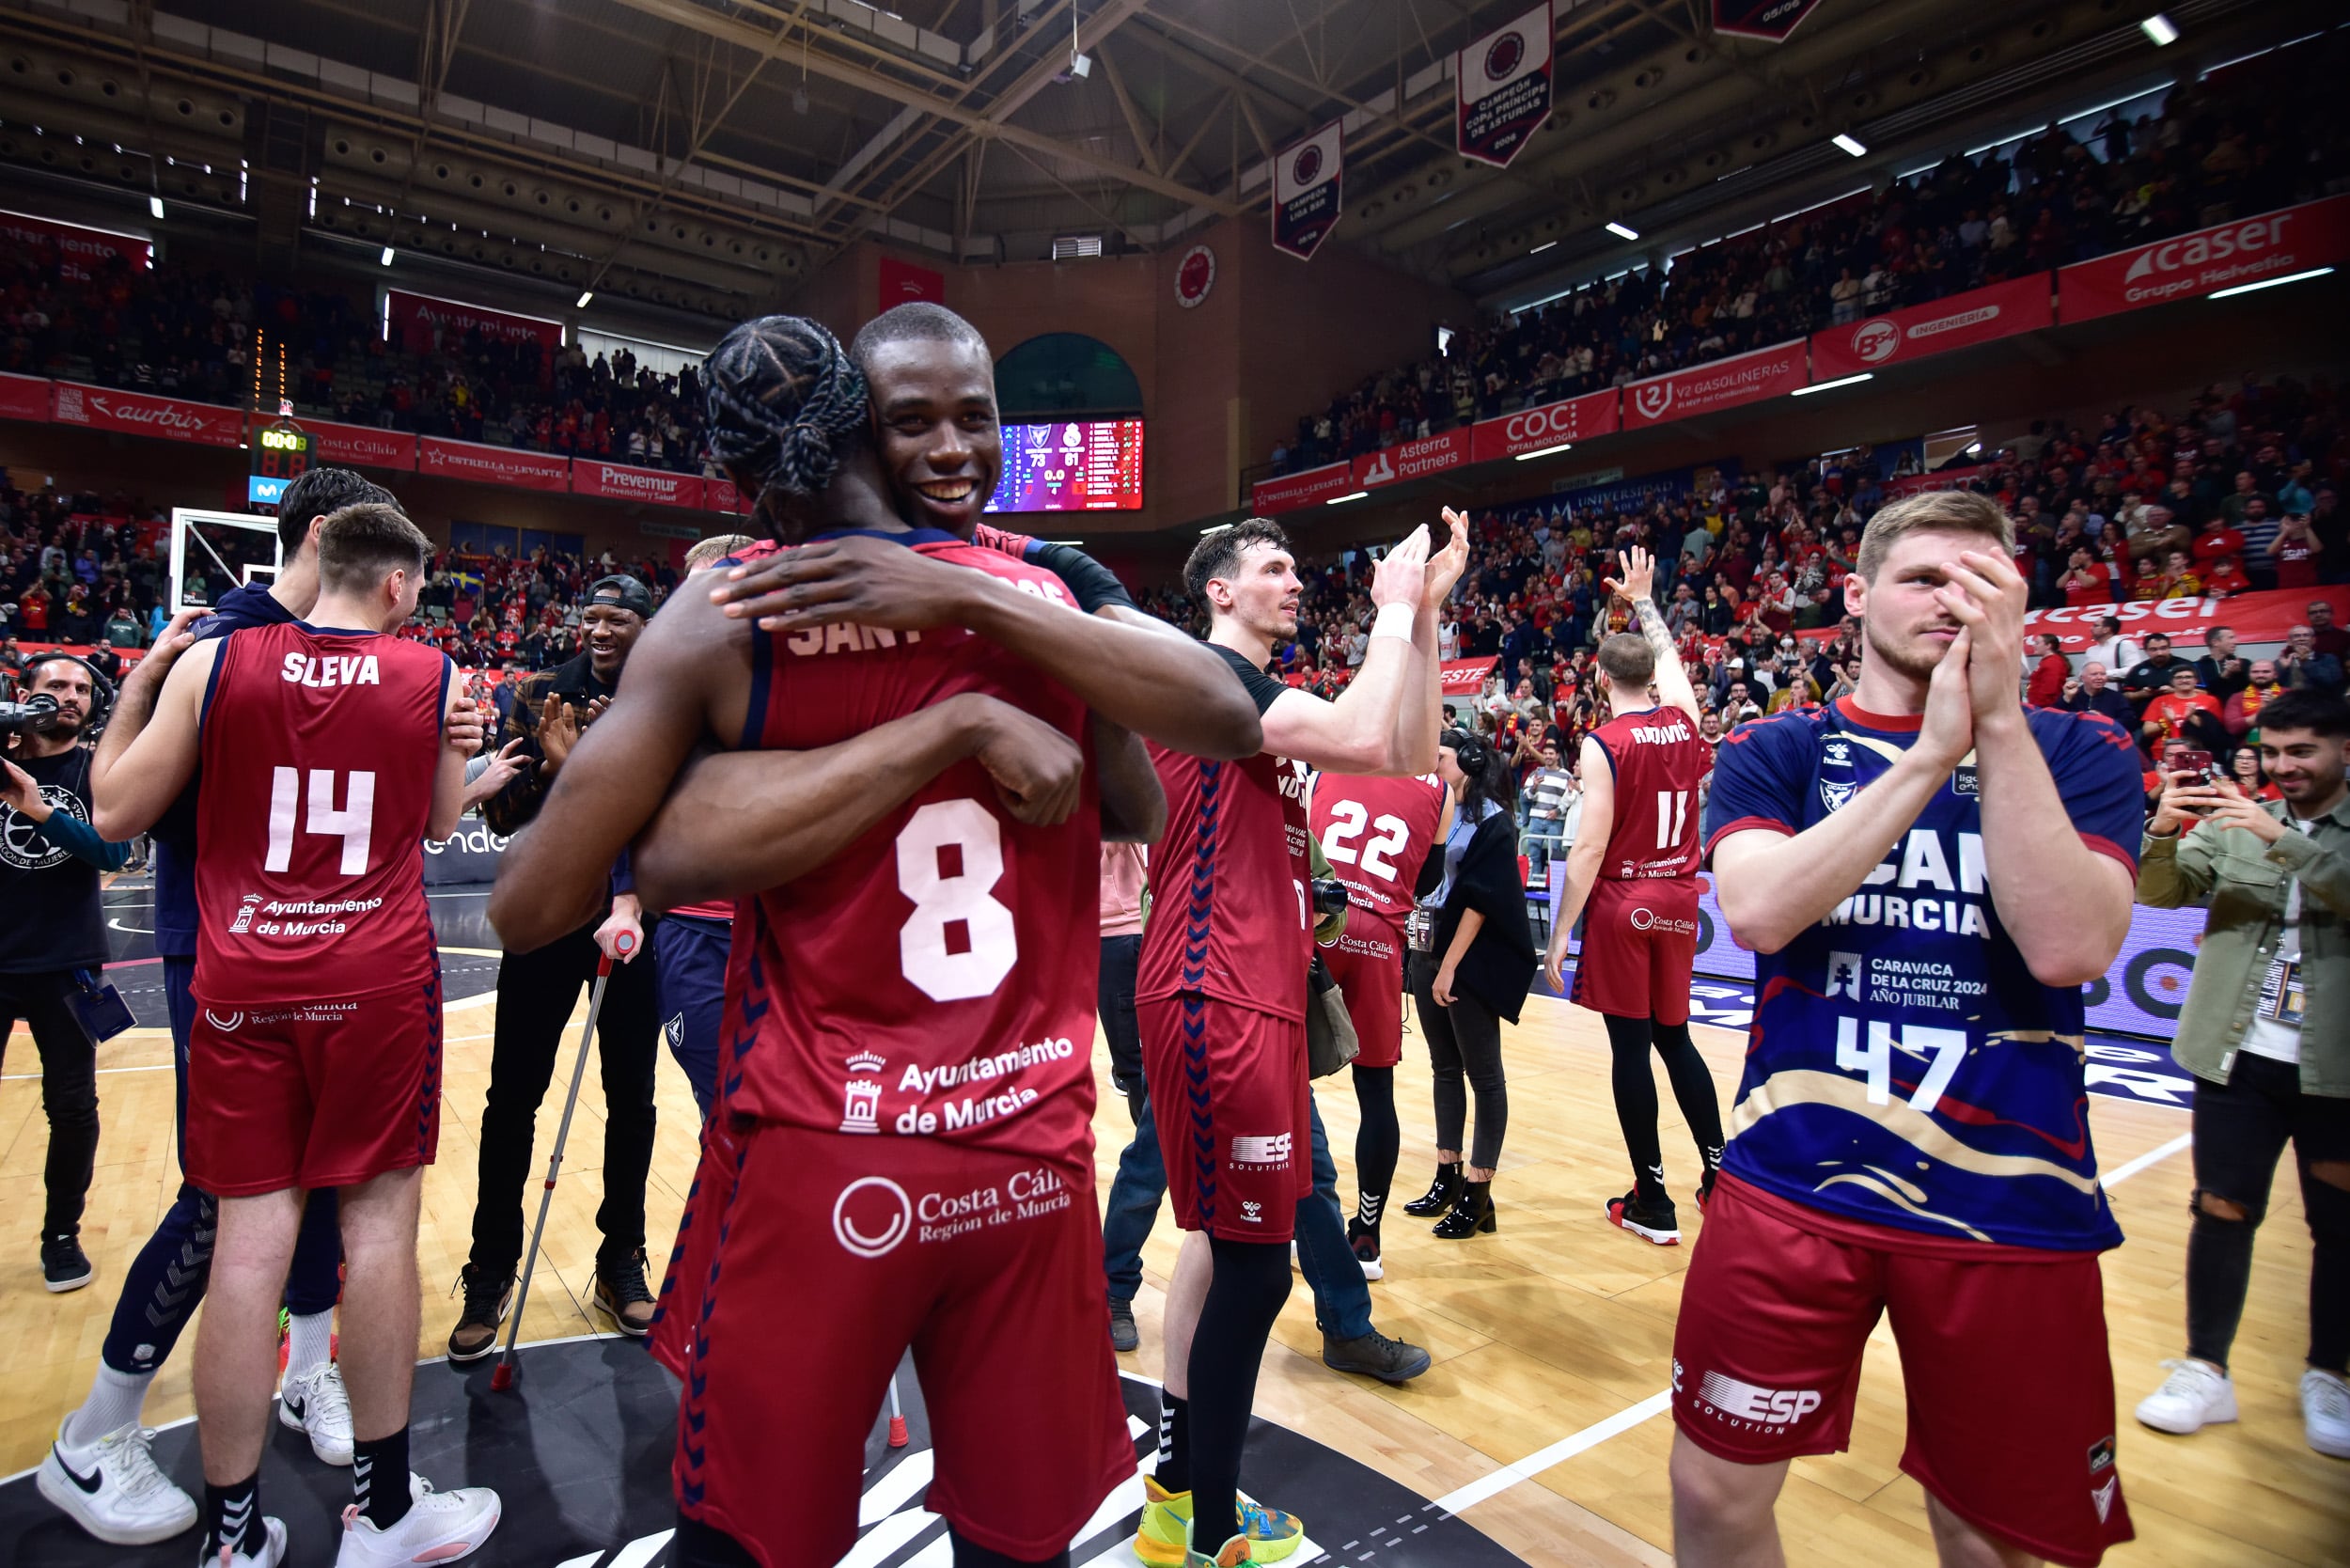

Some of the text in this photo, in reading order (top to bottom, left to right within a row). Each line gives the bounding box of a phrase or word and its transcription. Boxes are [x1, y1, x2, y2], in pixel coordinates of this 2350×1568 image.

[1466, 82, 1547, 130] COPA PRÍNCIPE
[1479, 77, 1530, 111] CAMPEÓN
[1471, 97, 1542, 138] DE ASTURIAS
[2155, 213, 2293, 272] caser
[2125, 252, 2295, 303] Grupo Helvetia
[1694, 361, 1790, 395] GASOLINERAS
[353, 438, 398, 456] Cálida
[1030, 453, 1045, 467] 73
[1399, 436, 1450, 460] Asterra
[448, 455, 505, 471] ESTRELLA
[515, 465, 563, 478] LEVANTE
[1399, 451, 1458, 477] Partners
[602, 465, 678, 493] Prevemur
[602, 484, 647, 497] Prevención
[654, 492, 677, 502] Salud
[1308, 477, 1344, 494] LEVANTE
[281, 651, 381, 688] SLEVA
[264, 765, 376, 876] 14
[1656, 791, 1689, 850] 11
[1321, 799, 1410, 883] 22
[1648, 869, 1677, 879] Murcia
[895, 797, 1019, 1003] 8
[1336, 877, 1391, 904] yuntamiento
[263, 896, 383, 917] Ayuntamiento
[1821, 895, 1992, 940] MURCIA
[256, 920, 346, 936] de Murcia
[1653, 916, 1673, 928] Costa
[1339, 943, 1361, 954] Región
[1370, 949, 1388, 960] Murcia
[1340, 933, 1394, 954] Costa Cálida
[1871, 957, 1954, 978] CARAVACA
[1869, 986, 1961, 1011] AÑO JUBILAR
[1871, 973, 1987, 996] DE LA CRUZ 2024
[305, 1010, 343, 1022] Murcia
[897, 1035, 1074, 1093] Ayuntamiento
[1836, 1015, 1967, 1113] 47
[896, 1085, 1039, 1136] de Murcia
[917, 1185, 1000, 1224] Costa
[917, 1192, 1072, 1245] Región de Murcia
[1746, 1389, 1822, 1425] ESP
